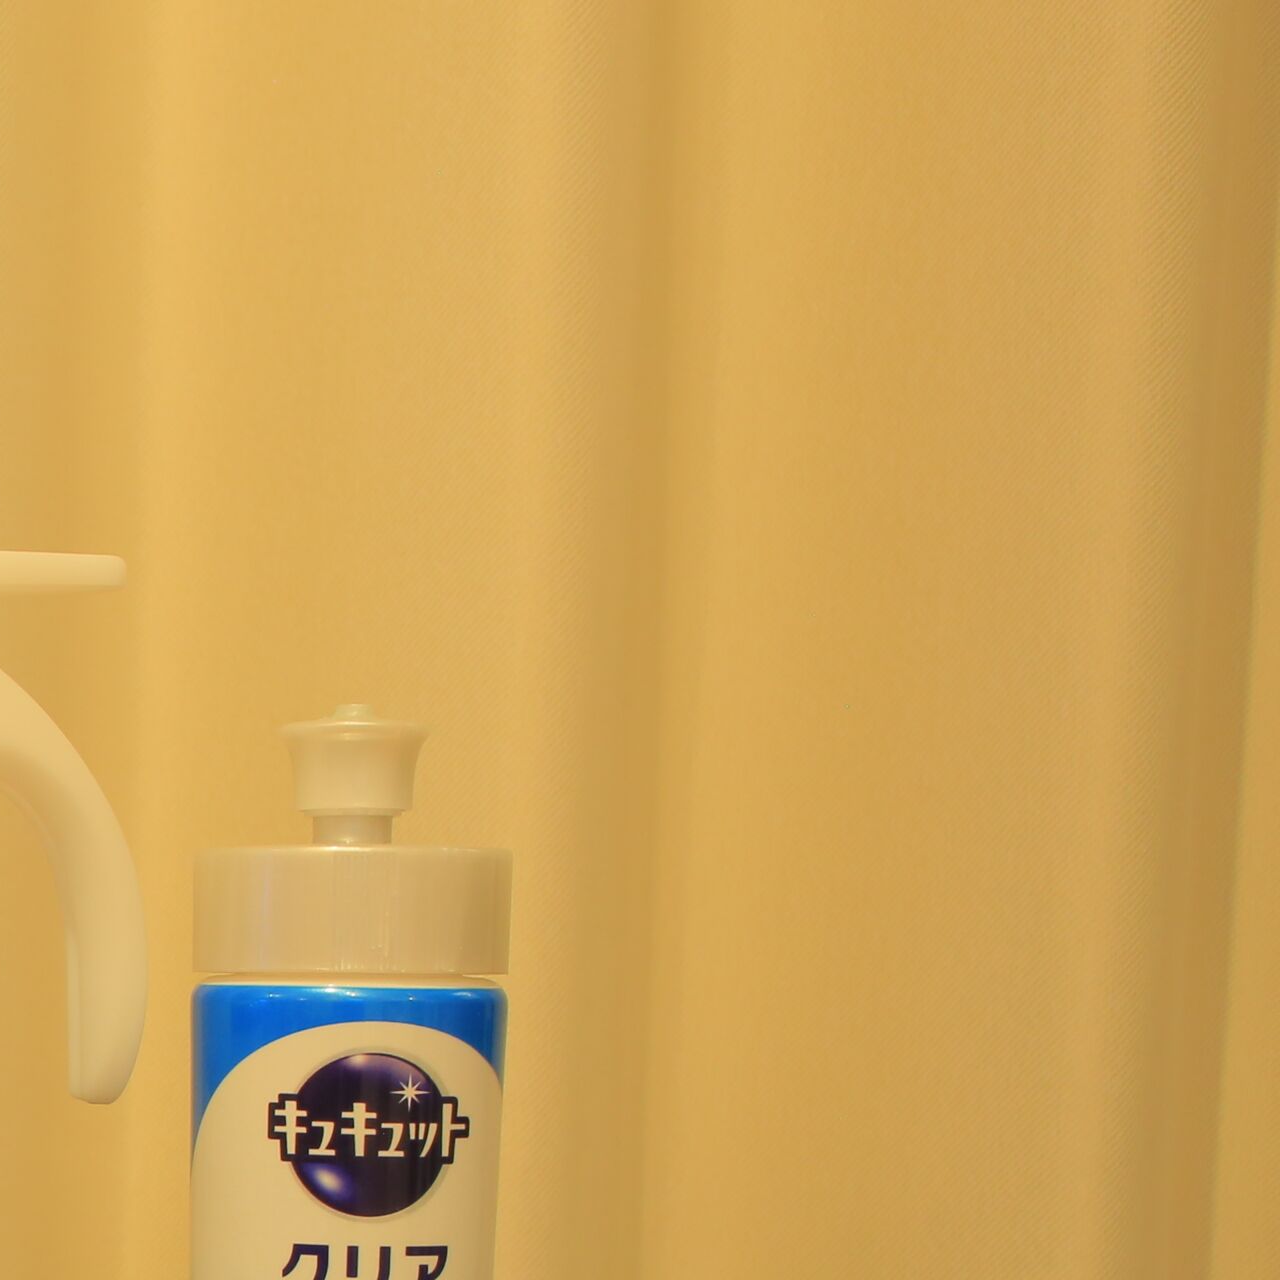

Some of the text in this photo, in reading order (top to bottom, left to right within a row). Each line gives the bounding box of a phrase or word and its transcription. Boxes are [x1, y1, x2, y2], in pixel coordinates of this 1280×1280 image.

[273, 1098, 466, 1159] キュキュット
